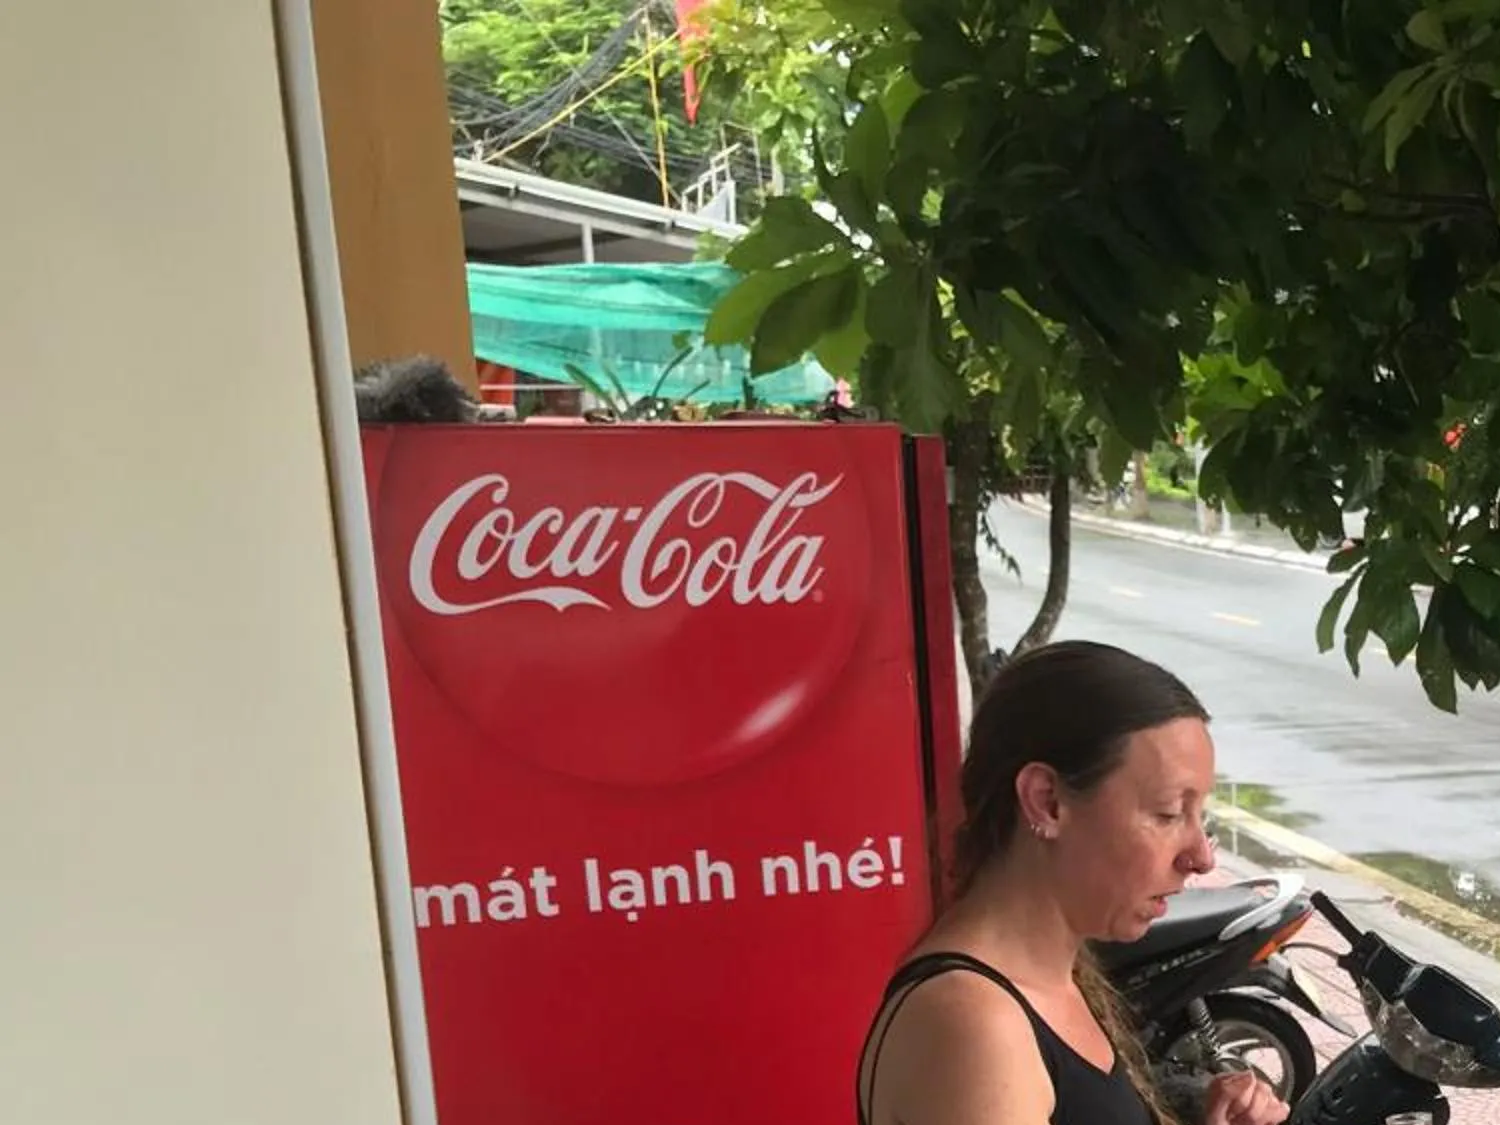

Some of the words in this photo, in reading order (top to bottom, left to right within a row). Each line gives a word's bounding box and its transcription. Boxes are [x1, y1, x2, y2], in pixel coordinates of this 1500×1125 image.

[410, 472, 845, 614] Coca-Cola
[413, 860, 559, 929] mát
[584, 849, 736, 923] lạnh
[761, 837, 905, 898] nhé!
